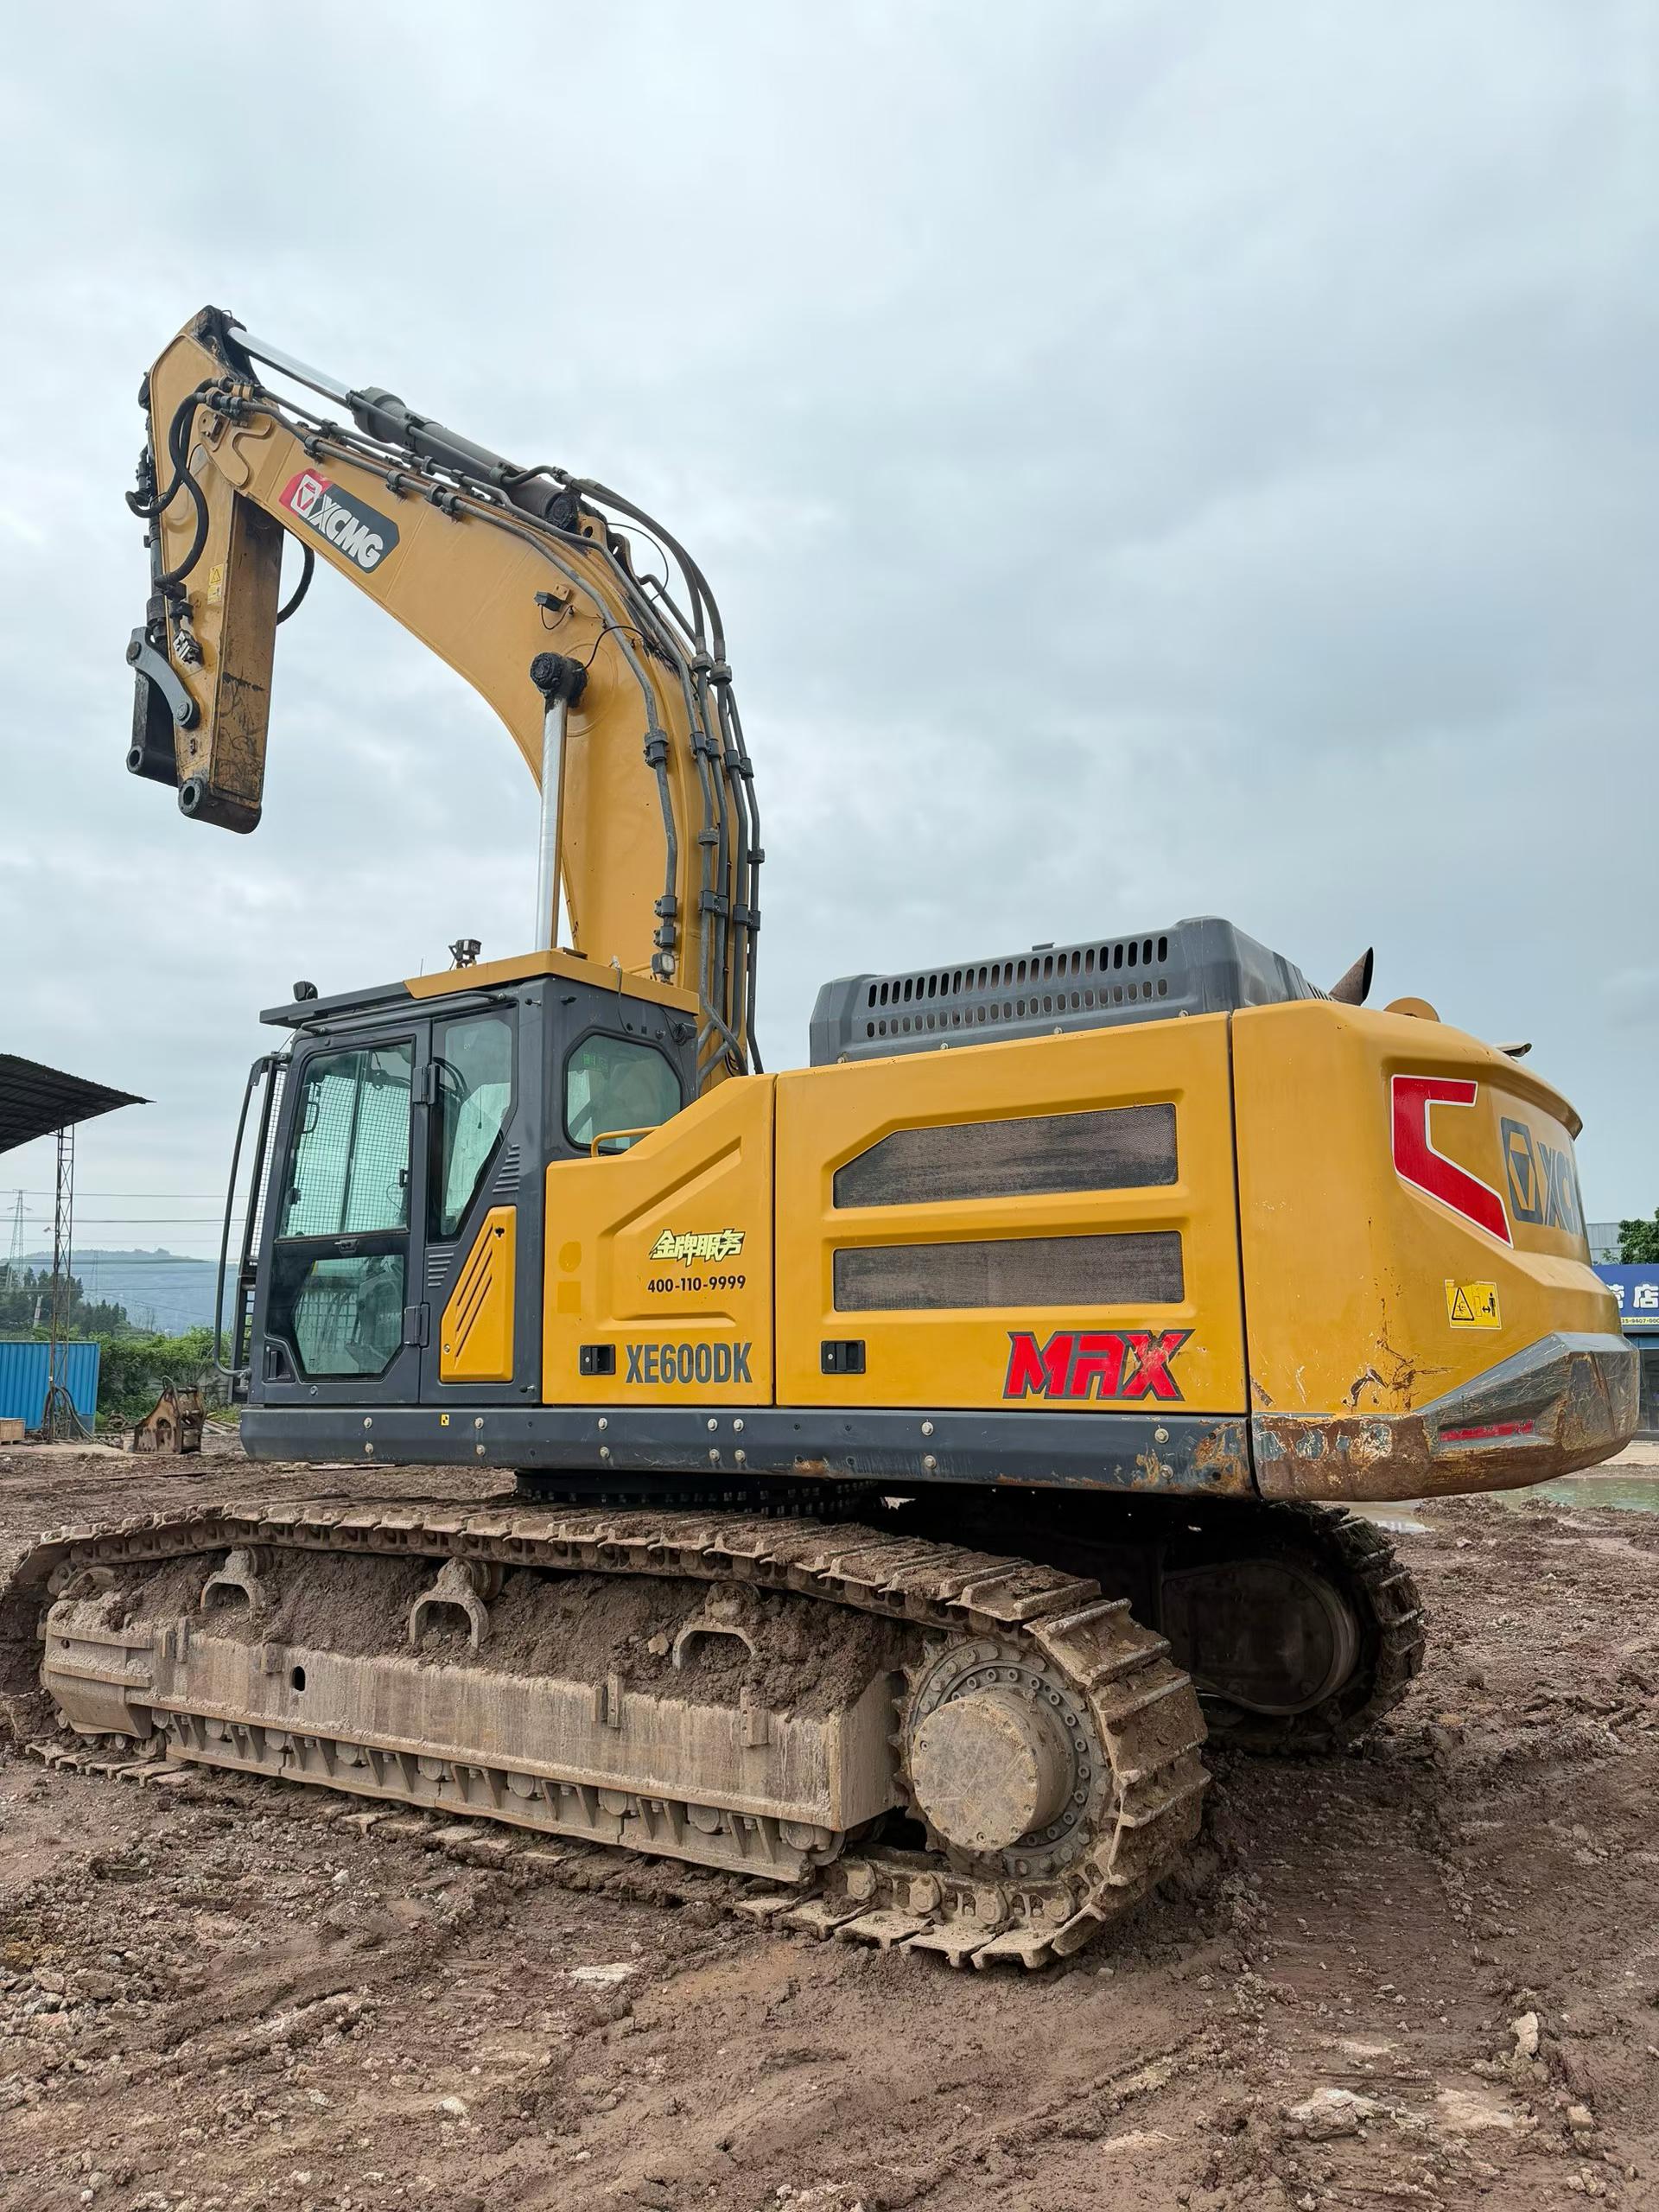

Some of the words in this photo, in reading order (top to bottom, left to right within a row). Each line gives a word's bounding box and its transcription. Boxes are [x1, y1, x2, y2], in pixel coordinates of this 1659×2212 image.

[307, 493, 384, 568] XCMG
[648, 1228, 746, 1268] 金牌服务
[647, 1274, 747, 1293] 400-110-9999
[625, 1342, 753, 1383] XE600DK
[1002, 1329, 1196, 1402] MAX
